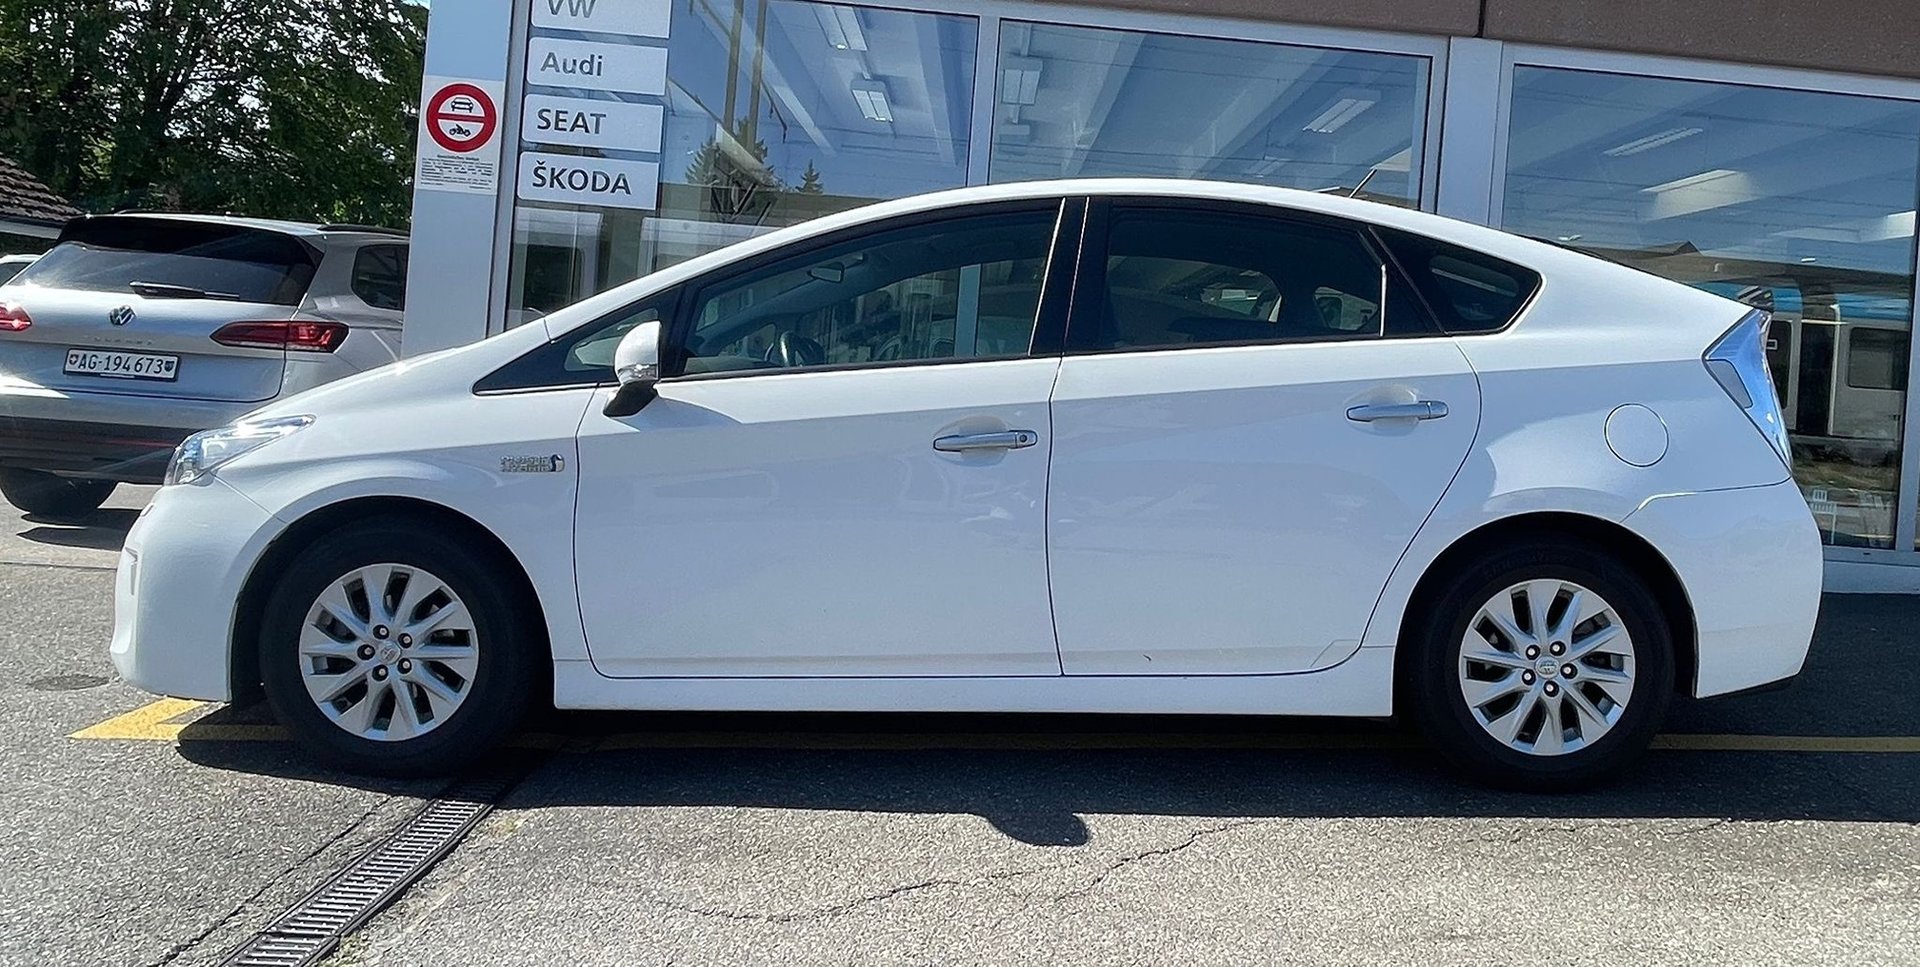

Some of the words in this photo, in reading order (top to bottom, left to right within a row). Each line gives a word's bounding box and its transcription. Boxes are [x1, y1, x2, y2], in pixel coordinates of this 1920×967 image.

[548, 0, 595, 18] VW
[541, 52, 603, 77] Audi
[537, 108, 607, 135] SEAT
[532, 160, 632, 196] ŠKODA
